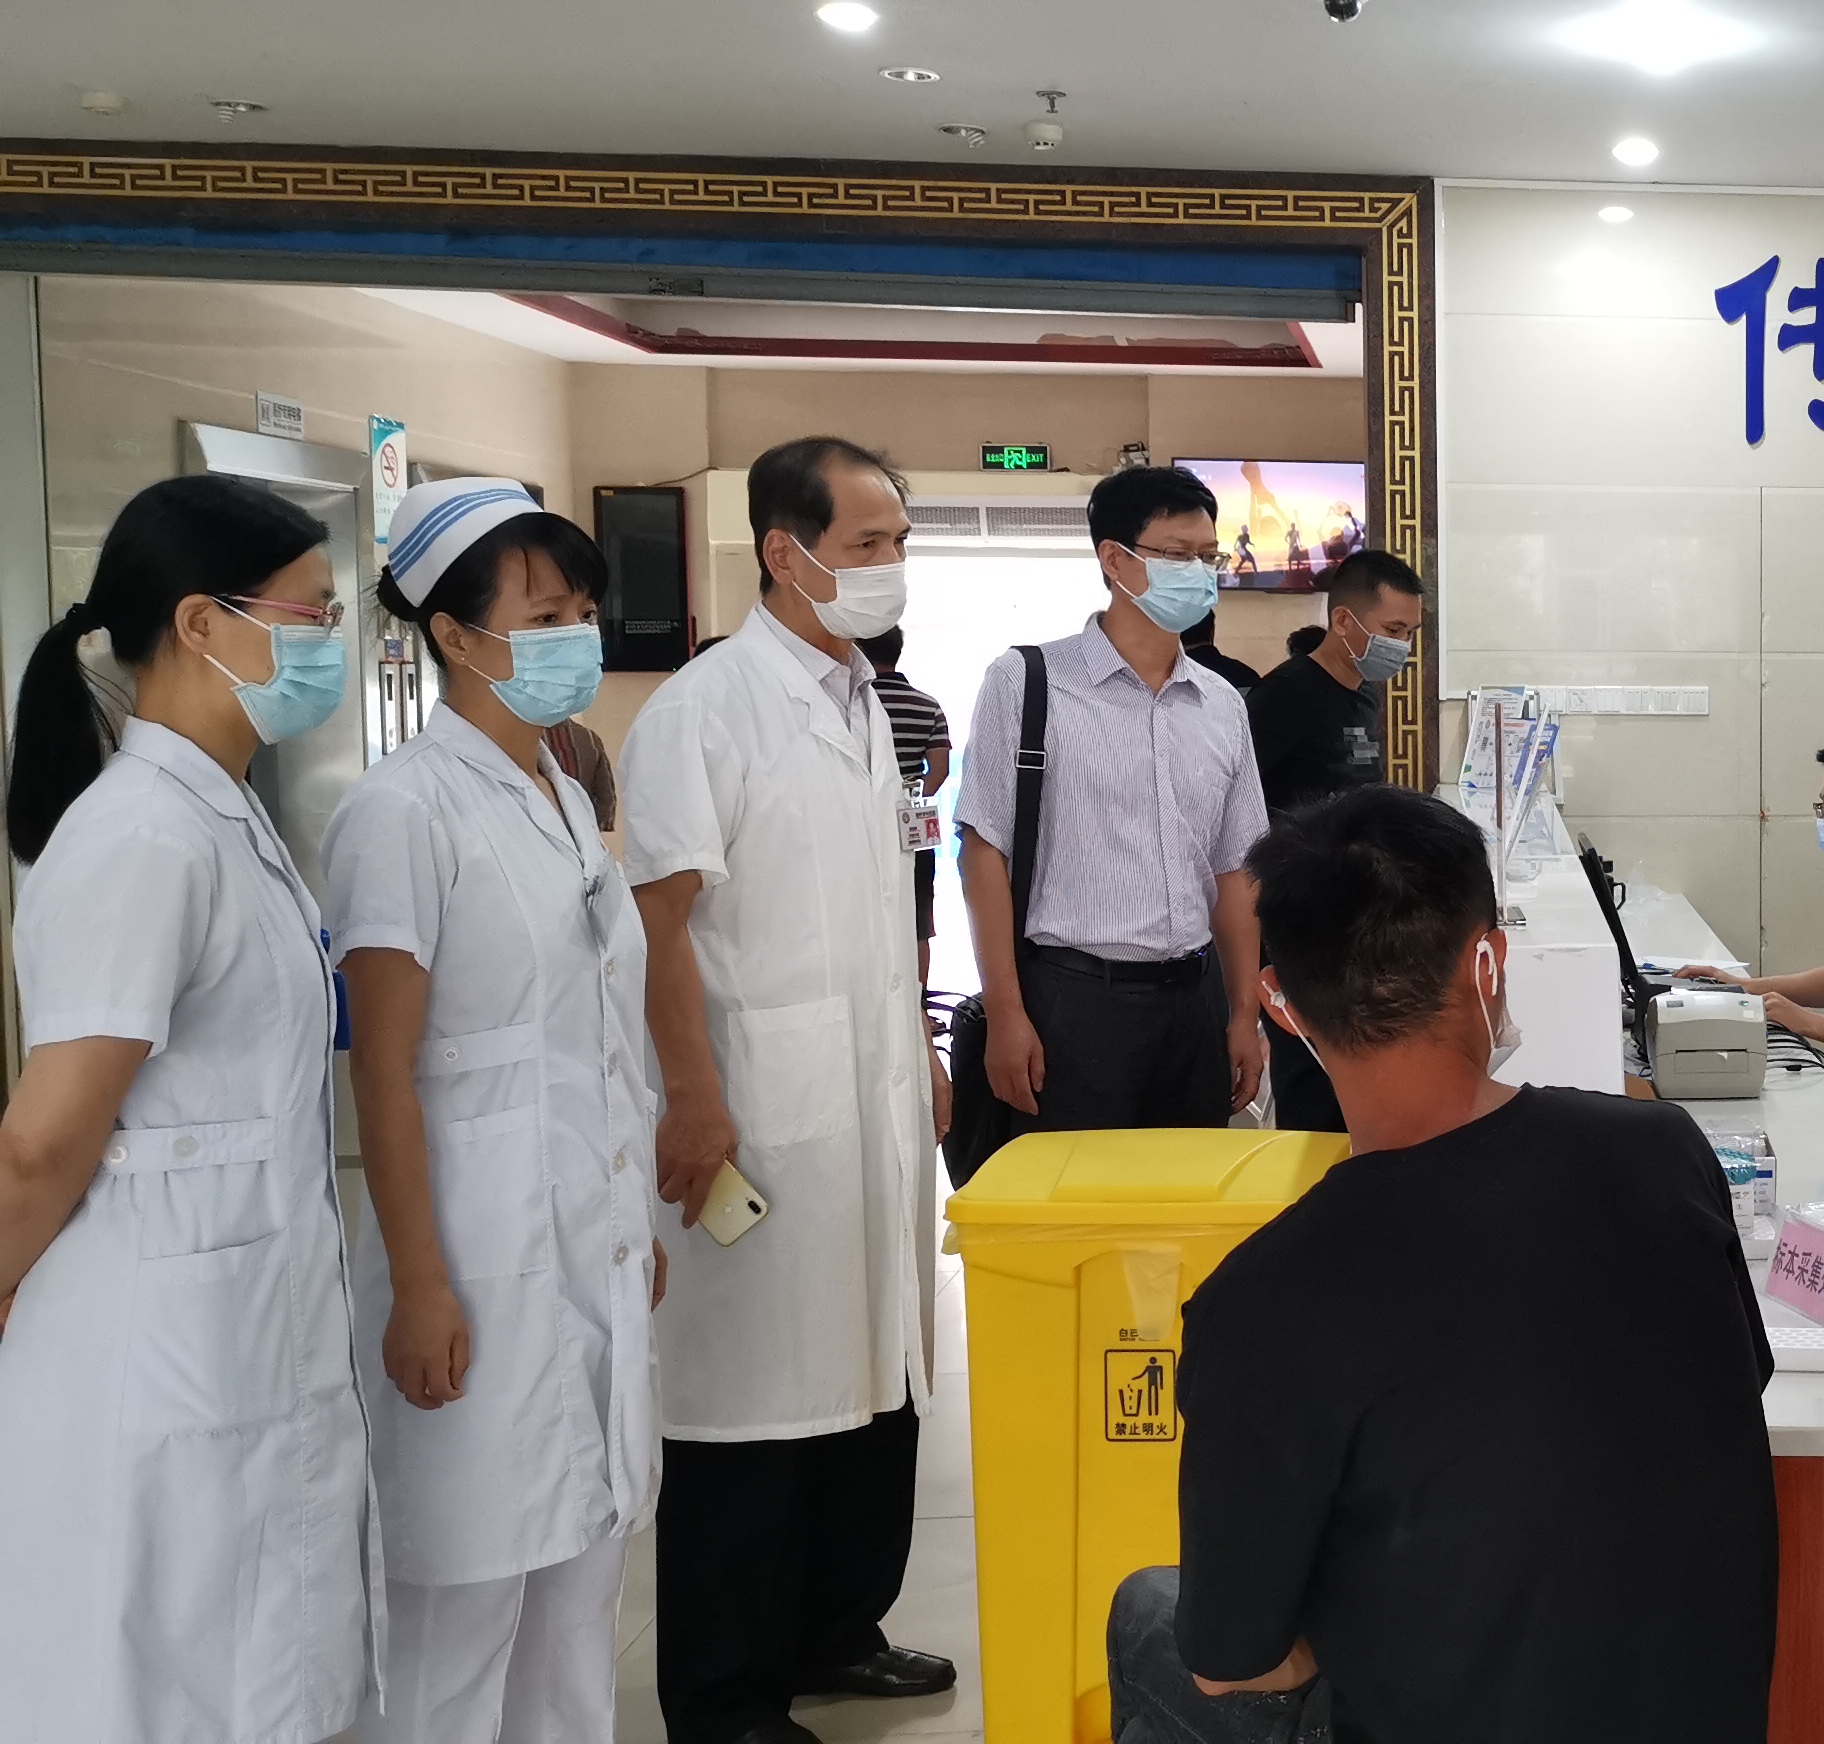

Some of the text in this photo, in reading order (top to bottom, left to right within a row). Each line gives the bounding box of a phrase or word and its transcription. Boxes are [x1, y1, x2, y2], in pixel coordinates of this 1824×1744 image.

[1027, 453, 1044, 462] EXIT
[1114, 1422, 1168, 1436] 禁止明火
